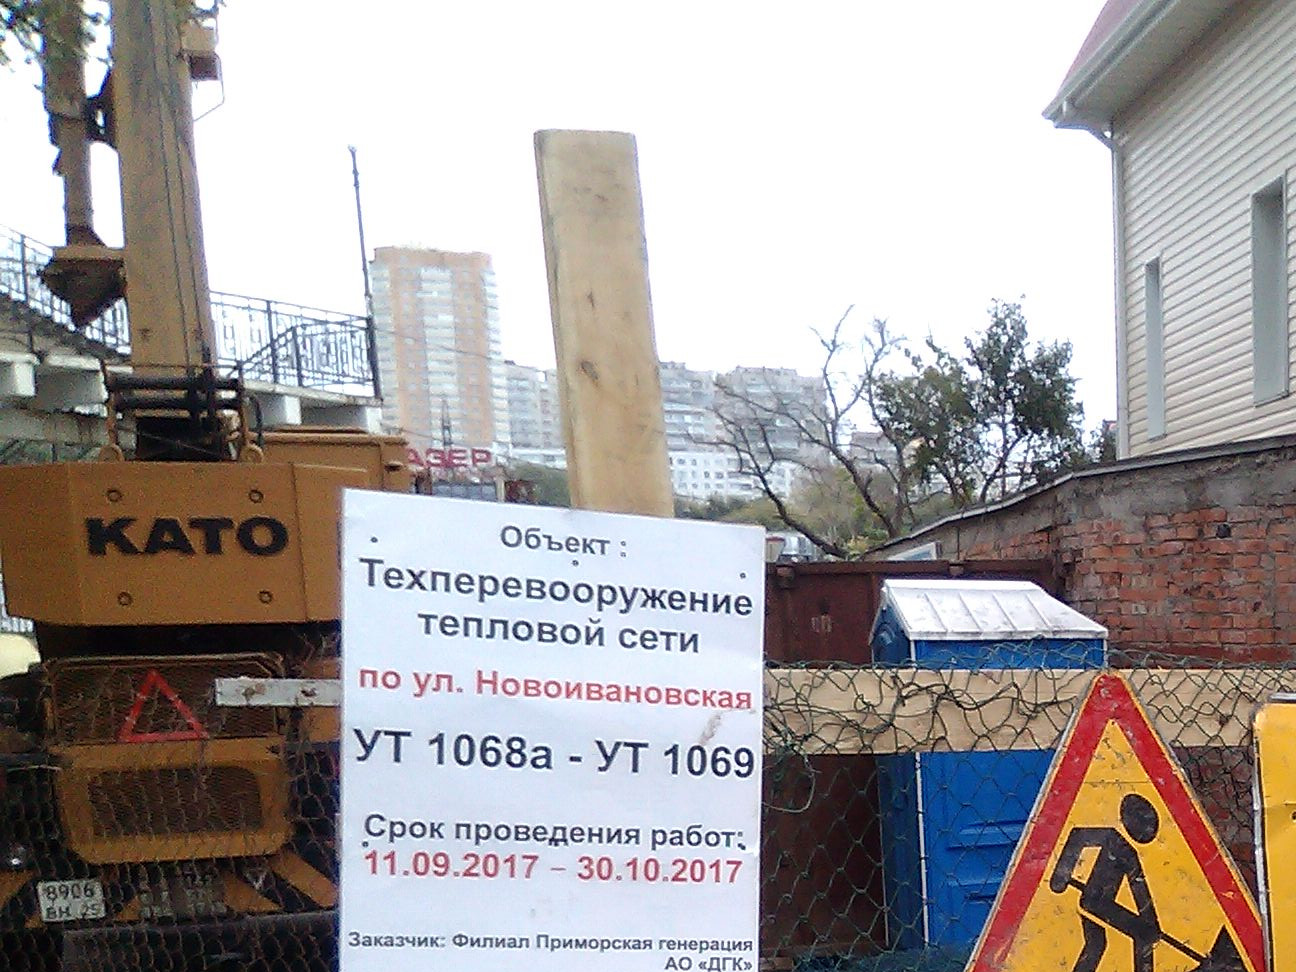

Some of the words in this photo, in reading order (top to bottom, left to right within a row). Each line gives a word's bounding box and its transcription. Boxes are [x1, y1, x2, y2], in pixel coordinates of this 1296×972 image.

[405, 448, 491, 468] АЗЕР
[86, 516, 290, 557] KATO
[359, 558, 752, 616] Техперевооружение
[418, 612, 604, 646] тепловой
[619, 629, 698, 653] сети
[360, 669, 401, 689] по
[413, 673, 462, 697] ул.
[477, 670, 751, 709] Новоивановская
[353, 729, 411, 763] УТ
[429, 733, 552, 769] 1068а
[595, 740, 648, 773] УТ
[664, 744, 754, 778] 1069
[365, 814, 444, 841] Срок
[455, 823, 640, 847] проведения
[652, 825, 743, 849] работ:
[365, 850, 539, 878] 11.09.2017
[578, 856, 742, 882] 30.10.2017
[349, 932, 445, 947] Заказчик:
[452, 934, 529, 948] Филиал
[537, 935, 652, 952] Приморская
[659, 940, 752, 953] генерация
[665, 957, 692, 970] АО
[698, 957, 752, 972] «ДГК»
